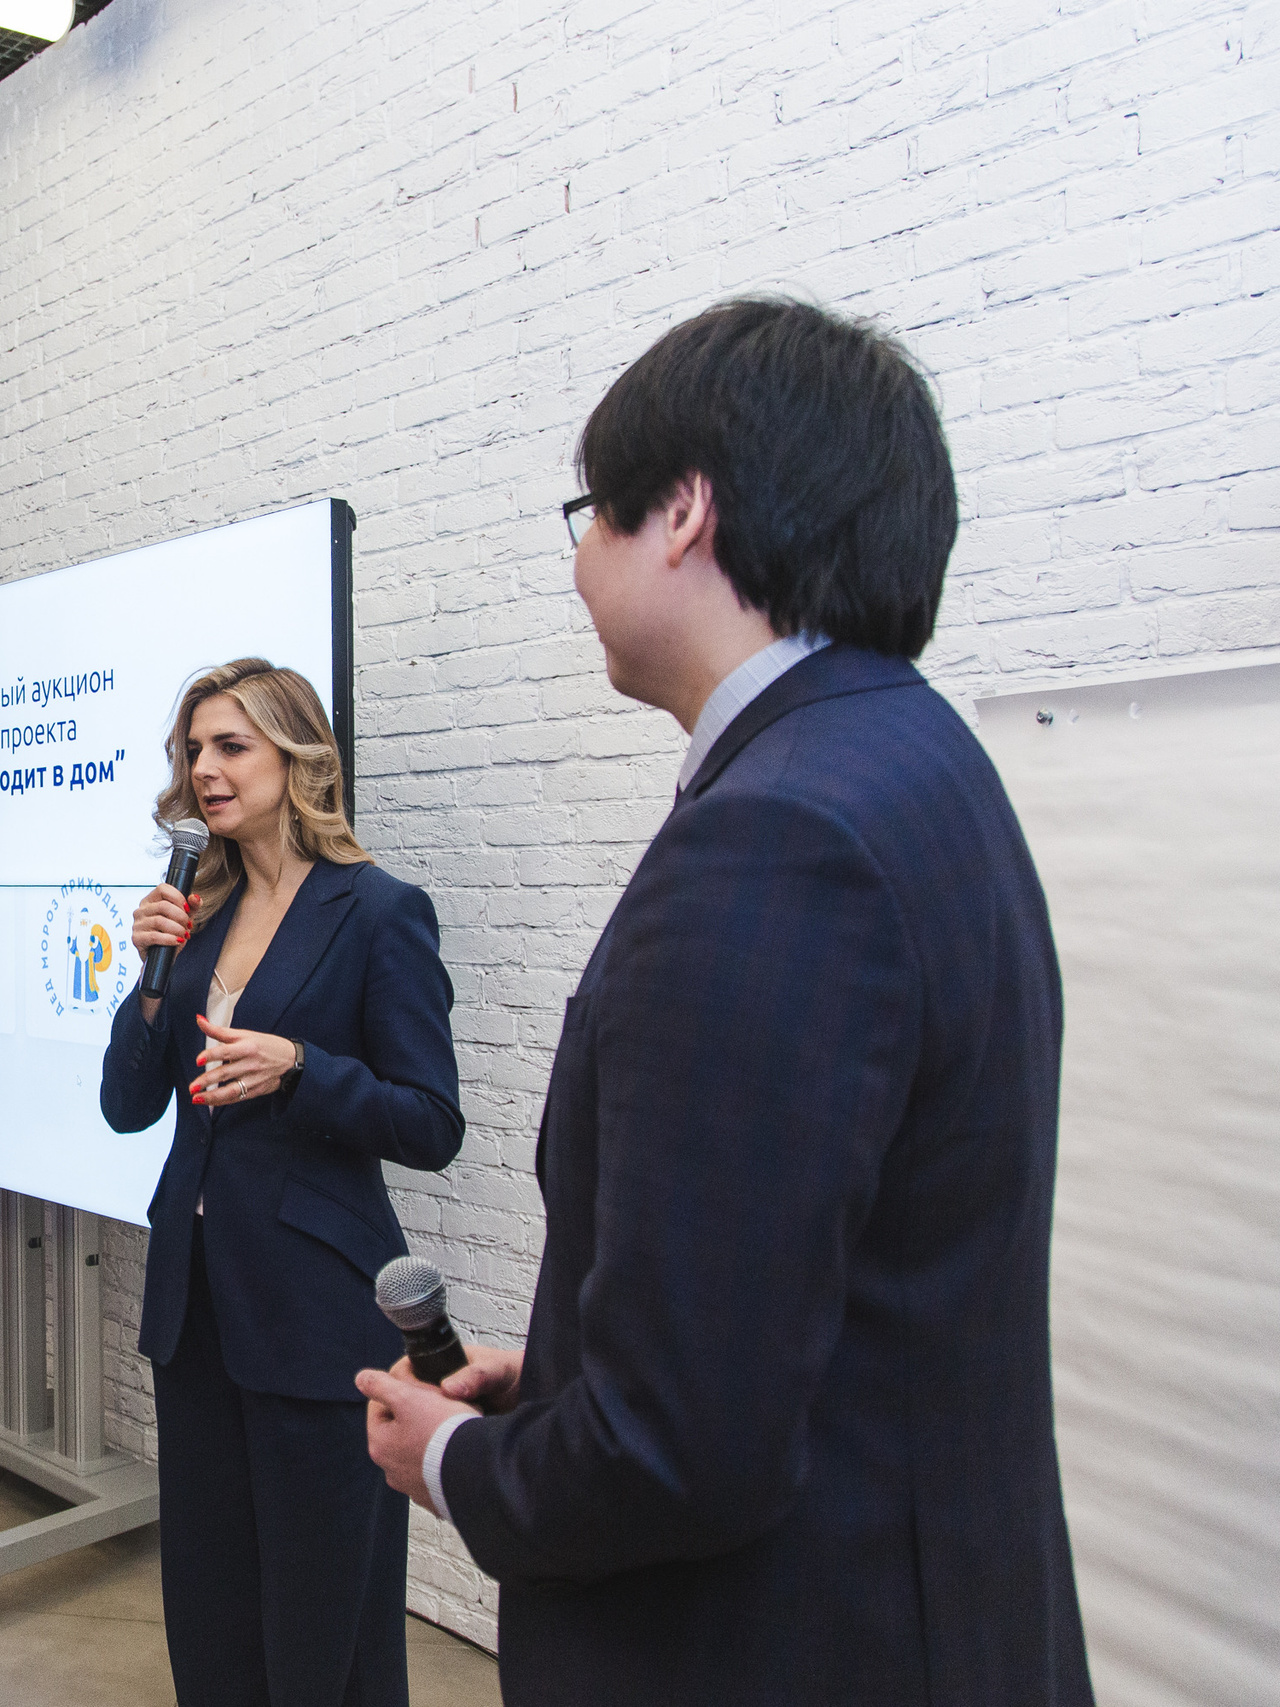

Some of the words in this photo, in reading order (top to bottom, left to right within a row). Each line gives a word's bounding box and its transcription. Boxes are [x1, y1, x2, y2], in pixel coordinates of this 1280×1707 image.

[31, 669, 114, 708] аукцион
[1, 720, 77, 755] проекта
[53, 765, 64, 787] в
[60, 877, 124, 929] ПРИХОДИТ
[41, 898, 59, 970] МОРОЗ
[118, 940, 127, 952] В
[45, 978, 65, 1017] ДЕД
